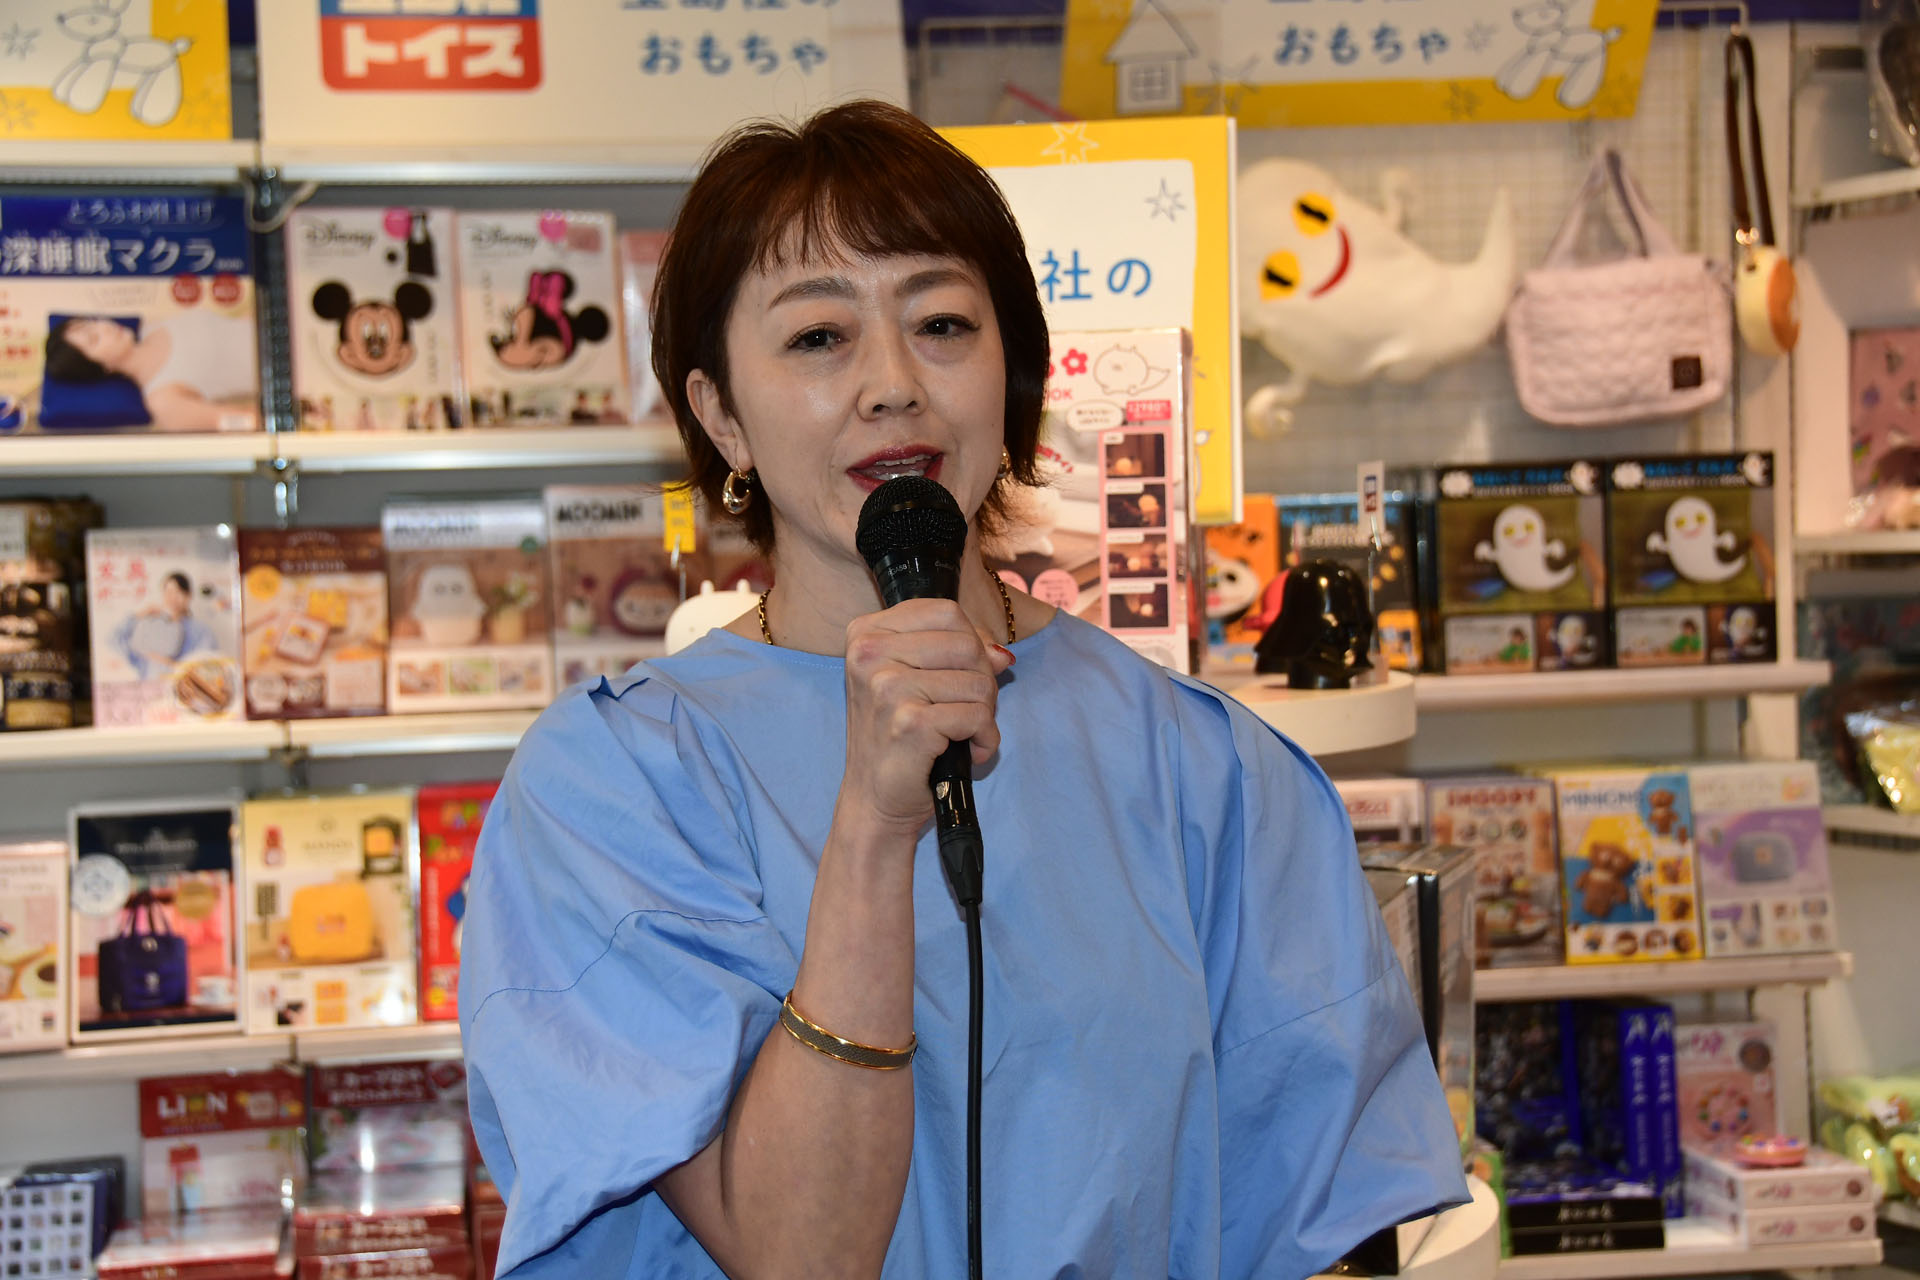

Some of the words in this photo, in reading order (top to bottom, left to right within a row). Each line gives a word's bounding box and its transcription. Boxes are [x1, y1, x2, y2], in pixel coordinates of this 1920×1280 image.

[639, 33, 827, 76] おもちゃ
[1274, 24, 1449, 66] おもちゃ
[1040, 250, 1152, 303] 社の
[157, 1091, 229, 1119] LION
